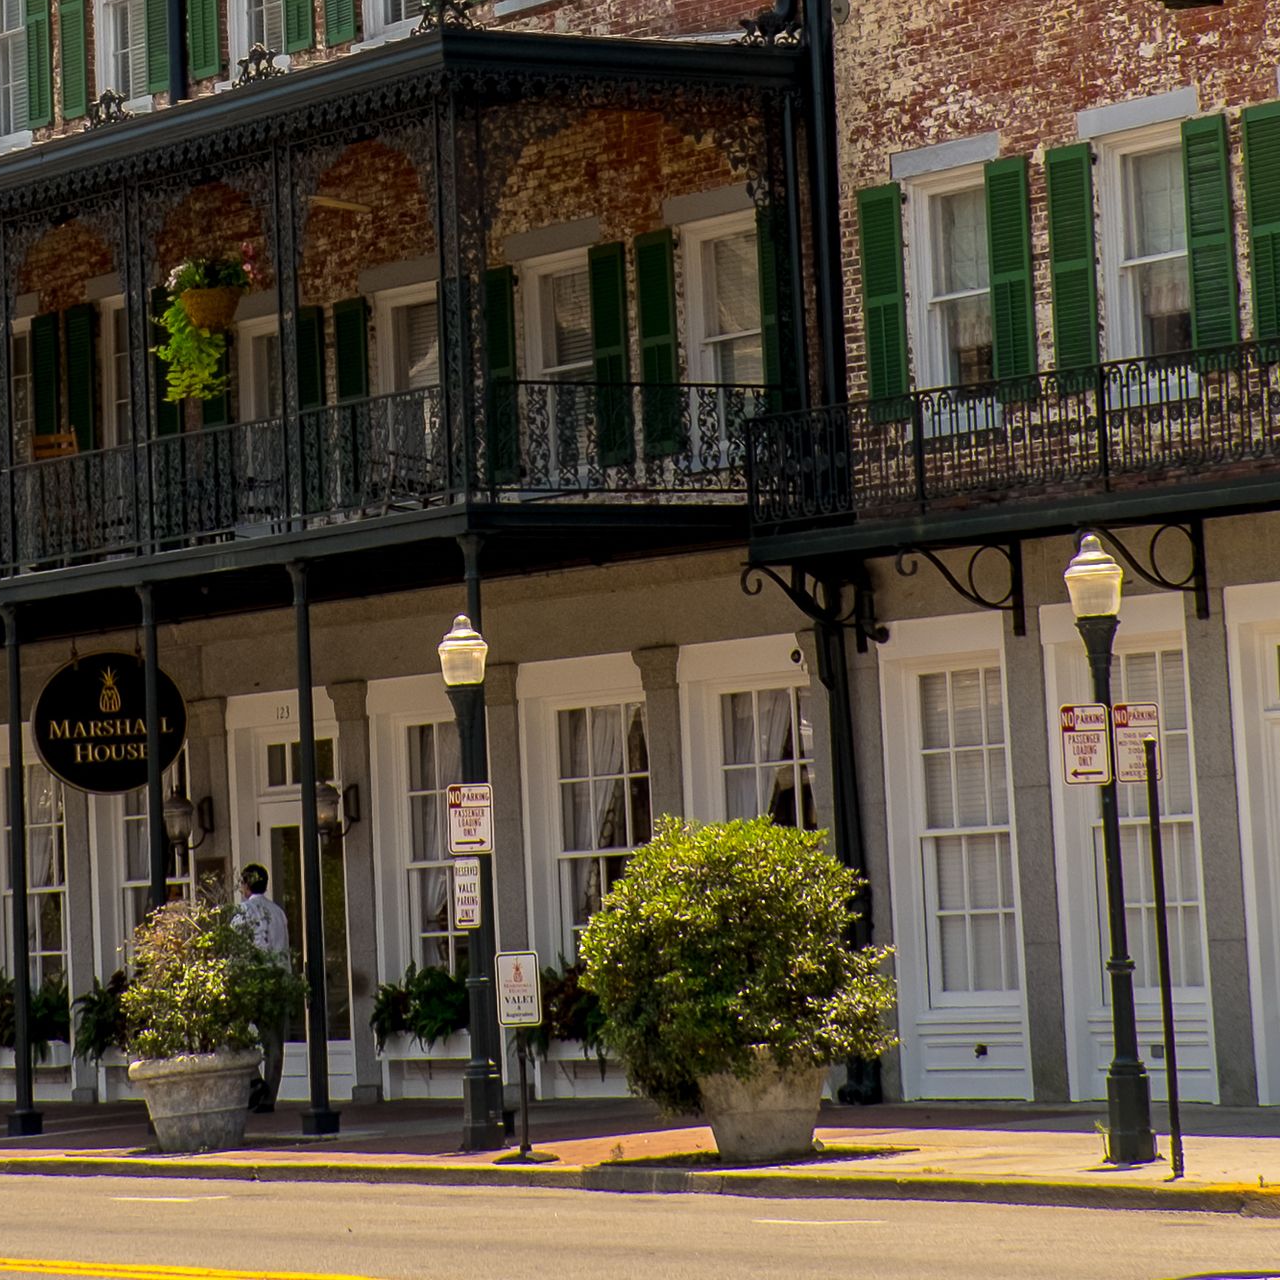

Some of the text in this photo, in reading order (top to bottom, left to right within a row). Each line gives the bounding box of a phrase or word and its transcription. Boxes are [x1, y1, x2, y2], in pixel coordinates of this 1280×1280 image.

[276, 705, 290, 720] 123
[1114, 710, 1157, 724] NO PARKING
[1062, 711, 1104, 728] NO PARKING
[49, 717, 173, 740] MARSHAL
[1068, 733, 1100, 744] PASSENGER
[74, 743, 148, 763] HOUSE
[1073, 744, 1097, 756] LOADING
[1078, 756, 1092, 767] ONLY
[449, 790, 489, 804] NO PARKING
[454, 808, 484, 818] PASSENGER
[463, 828, 477, 837] ONLY
[458, 883, 476, 893] VALET
[457, 896, 478, 906] PARKING
[505, 995, 534, 1004] VALET
